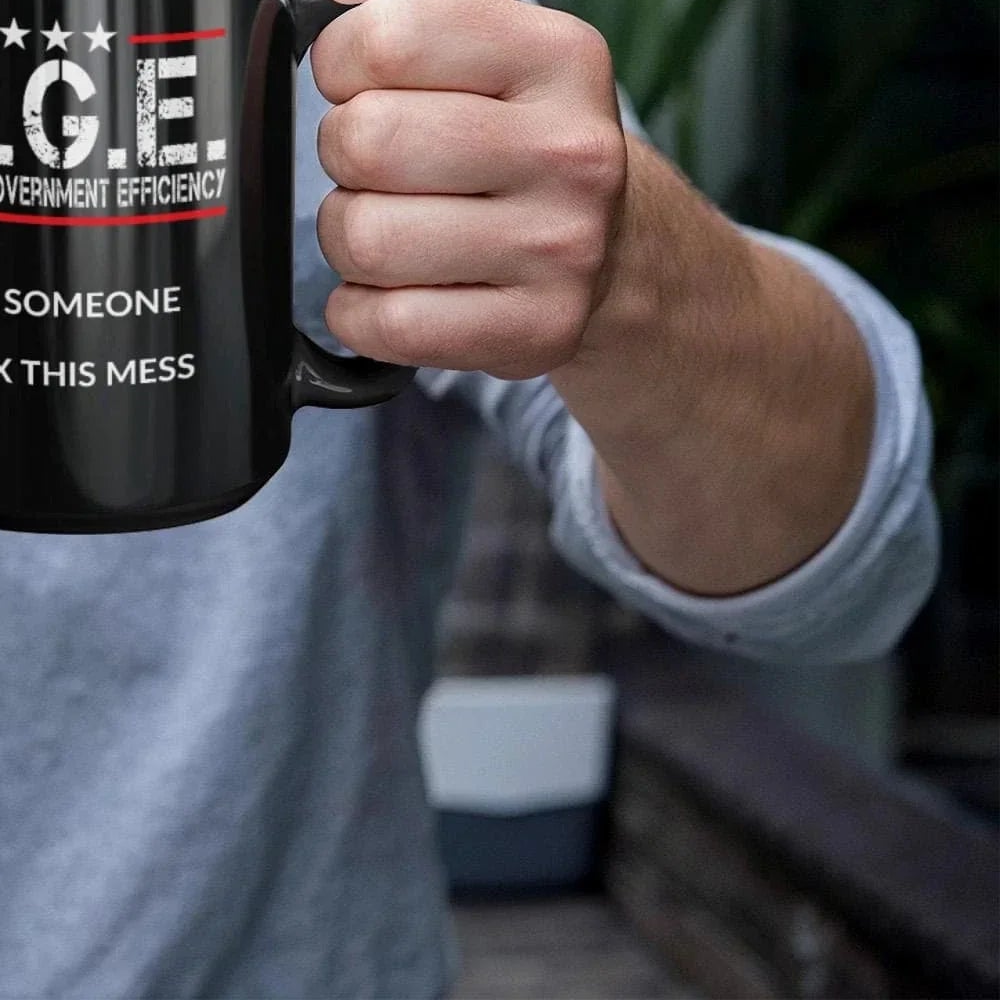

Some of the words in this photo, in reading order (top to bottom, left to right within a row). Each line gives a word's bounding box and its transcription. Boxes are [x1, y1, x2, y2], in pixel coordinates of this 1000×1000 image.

[117, 165, 228, 209] EFFICIENCY
[4, 286, 181, 319] SOMEONE
[21, 359, 97, 388] THIS
[107, 353, 195, 387] MESS
